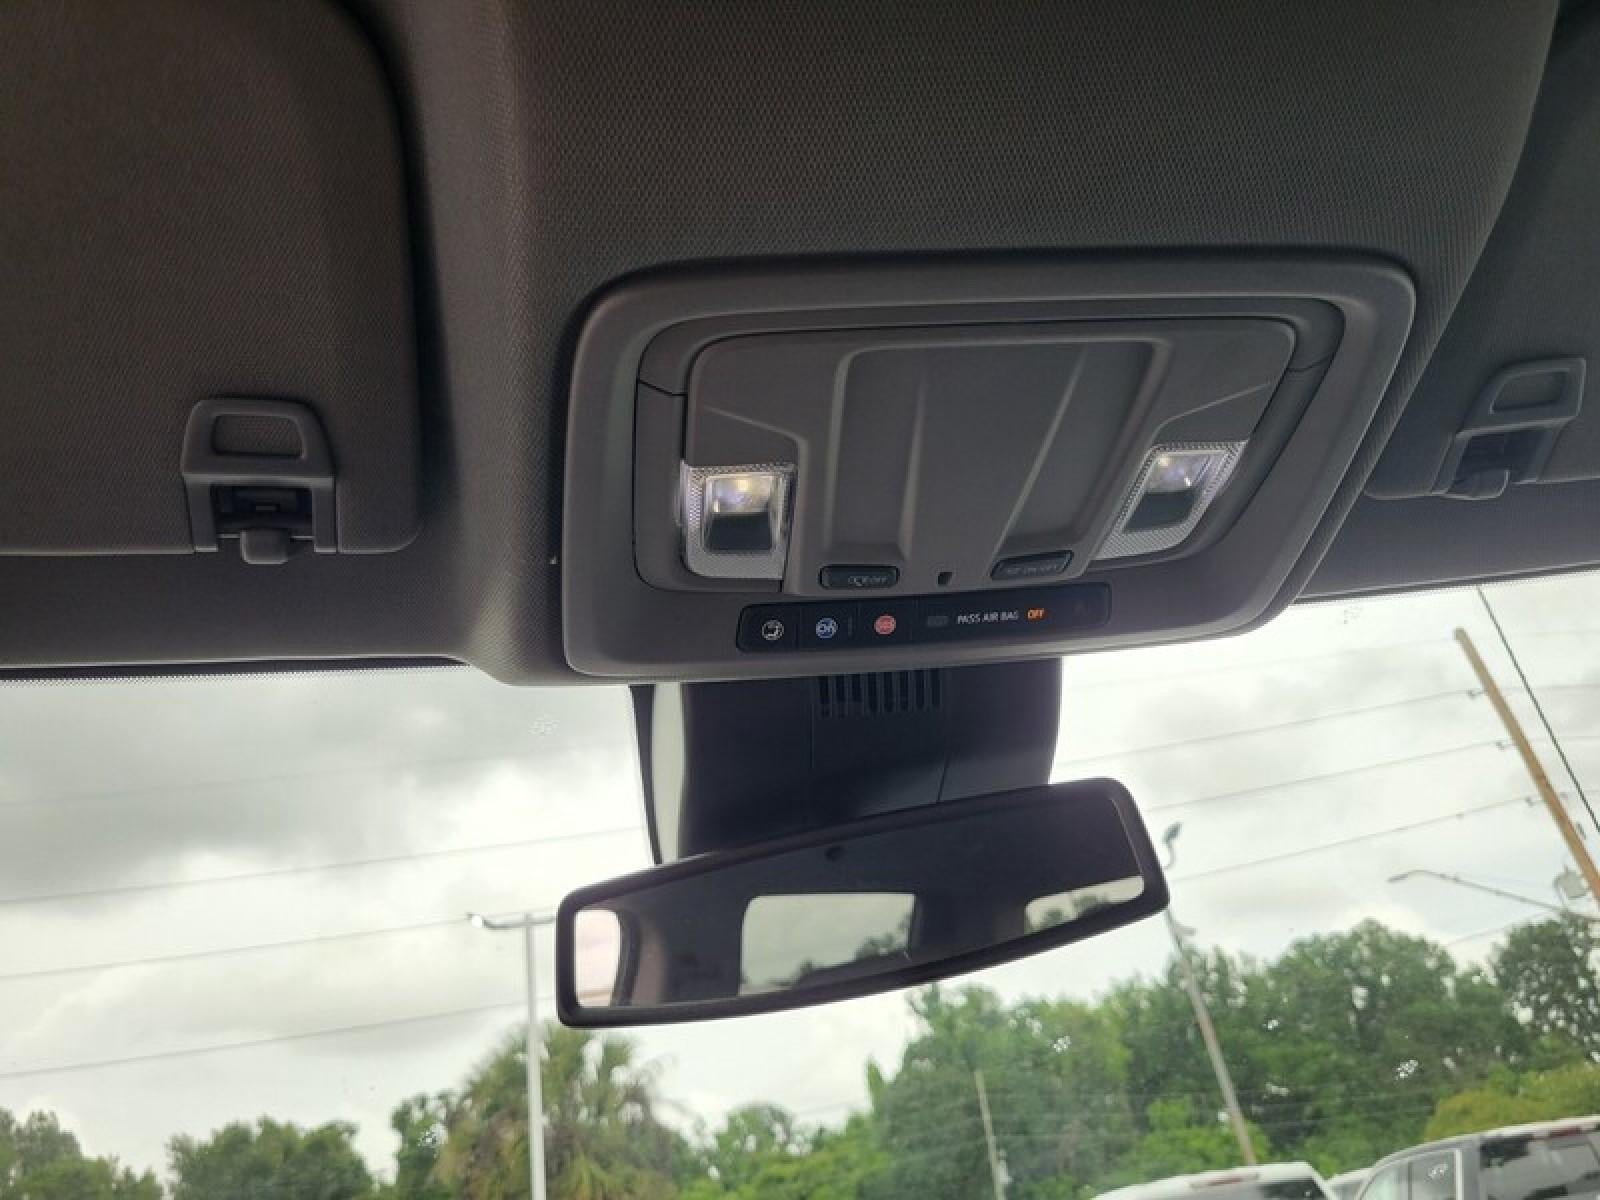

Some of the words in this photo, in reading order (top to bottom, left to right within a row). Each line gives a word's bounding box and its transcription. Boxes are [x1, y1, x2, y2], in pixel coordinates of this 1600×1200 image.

[957, 613, 981, 625] PASS
[983, 611, 999, 623] AIR
[1000, 610, 1019, 622] BAG
[1027, 607, 1046, 620] OFF
